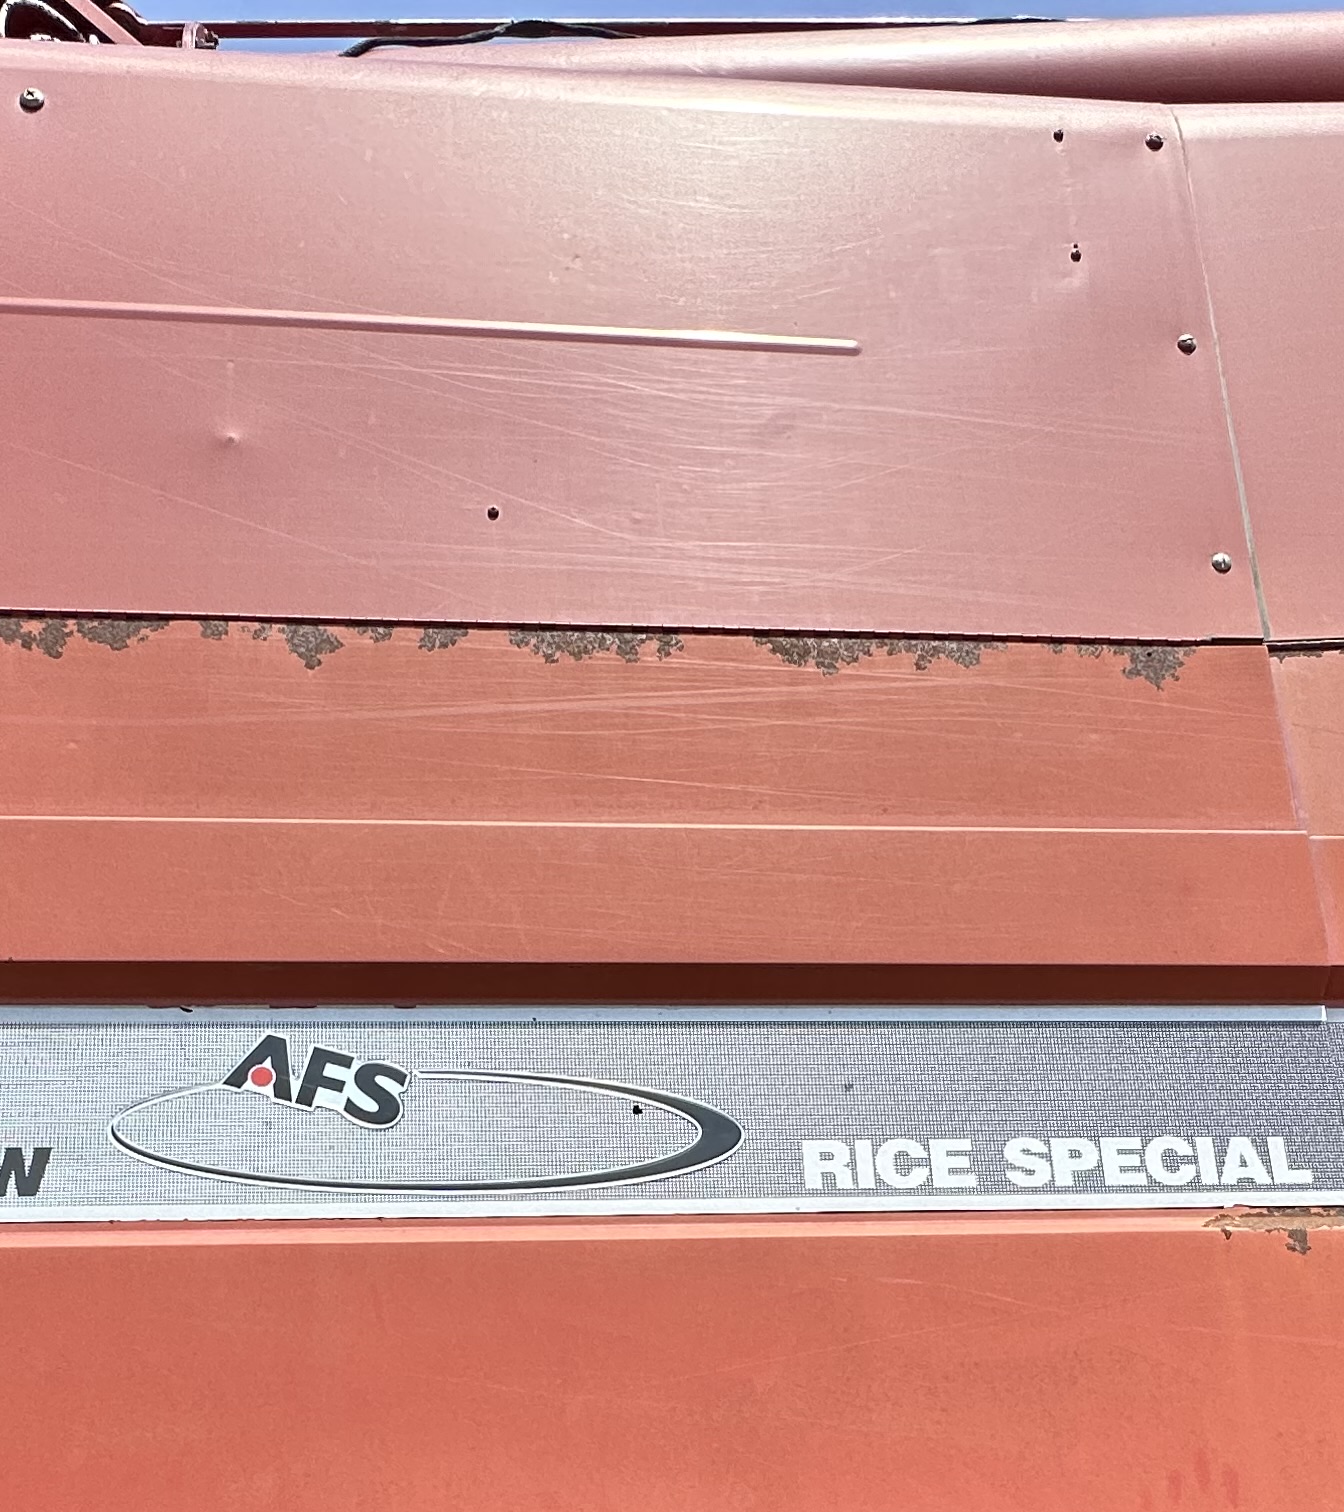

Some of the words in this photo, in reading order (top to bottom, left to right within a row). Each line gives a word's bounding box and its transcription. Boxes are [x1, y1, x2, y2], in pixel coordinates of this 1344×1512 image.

[222, 1034, 409, 1128] AFS
[802, 1138, 978, 1189] RICE
[1002, 1136, 1313, 1188] SPECIAL
